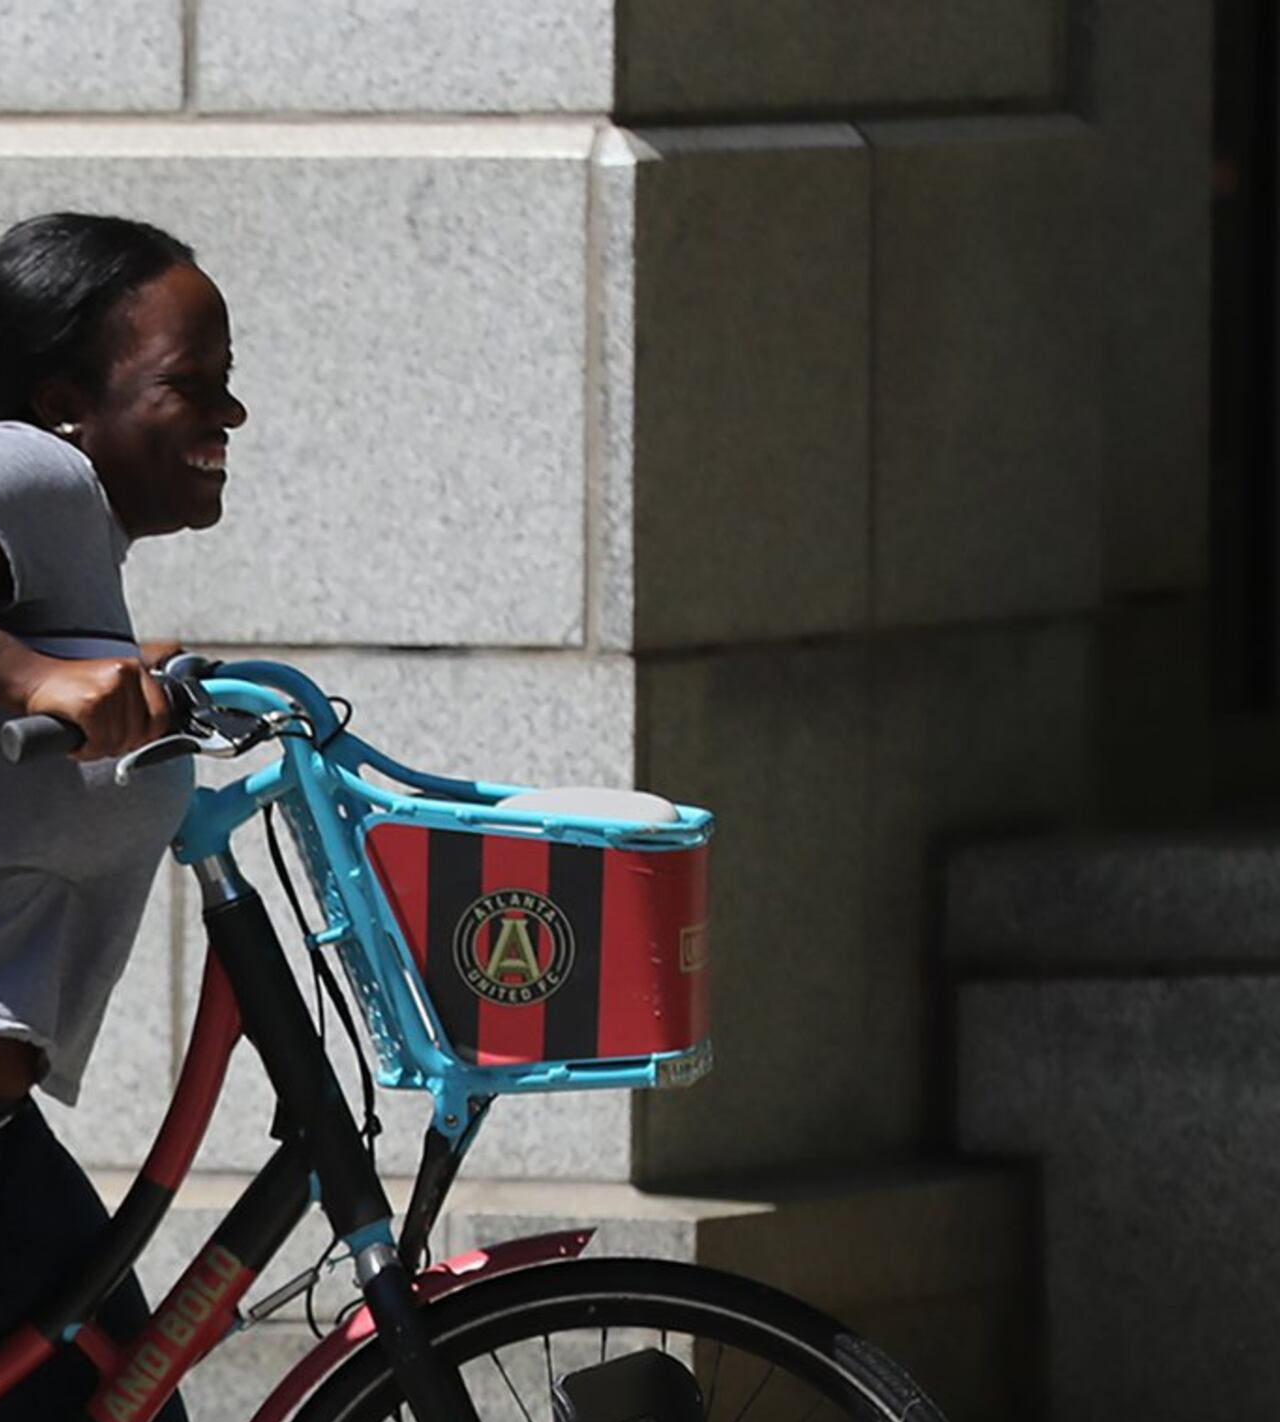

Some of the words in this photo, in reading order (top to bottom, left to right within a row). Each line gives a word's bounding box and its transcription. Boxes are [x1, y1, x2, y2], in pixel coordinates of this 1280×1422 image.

[473, 893, 557, 922] ATLANTA
[467, 968, 532, 1002] UNITED
[537, 972, 560, 993] FC
[159, 1245, 240, 1344] BOLD
